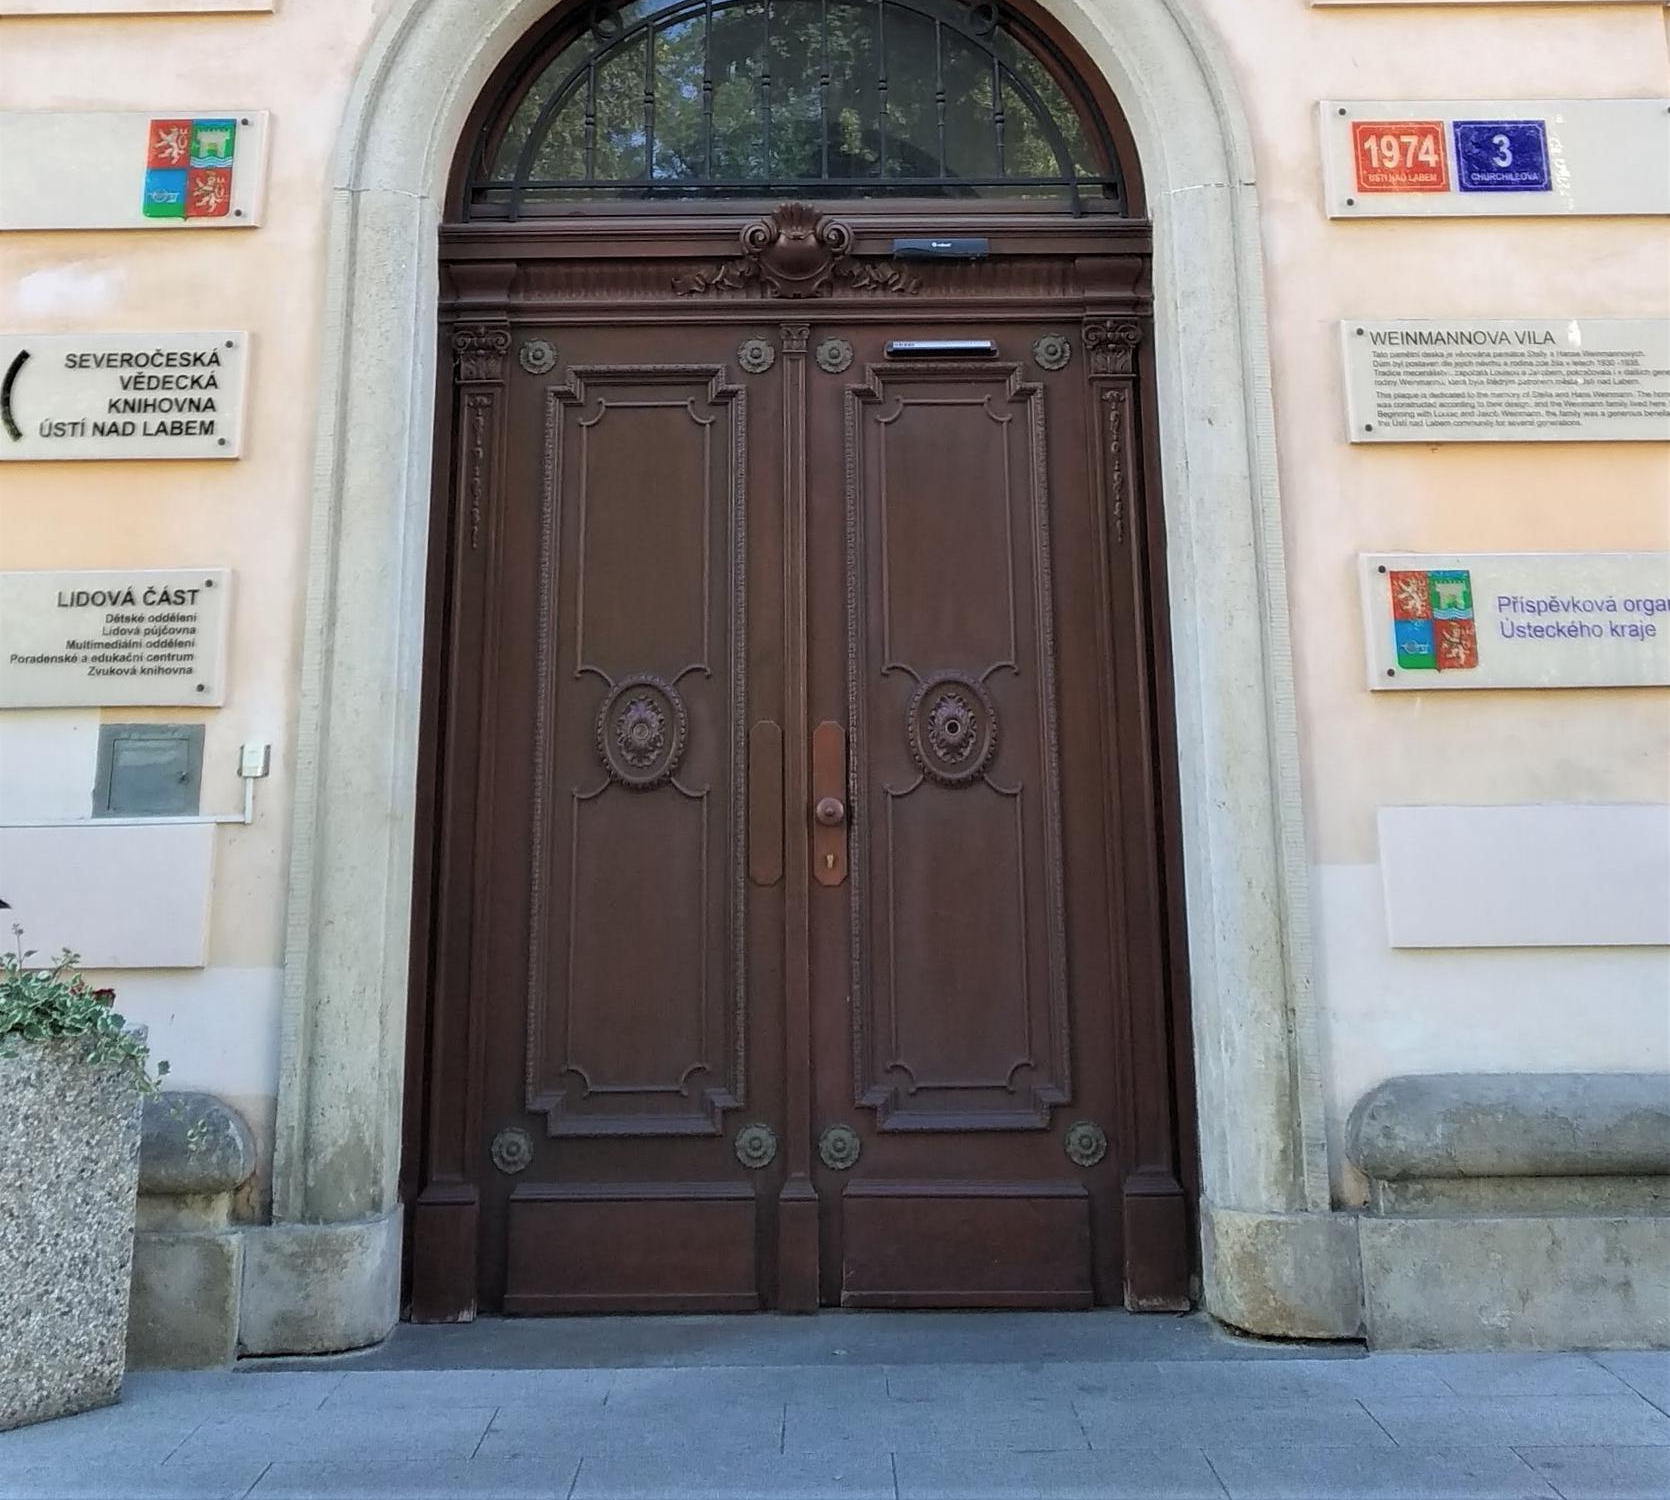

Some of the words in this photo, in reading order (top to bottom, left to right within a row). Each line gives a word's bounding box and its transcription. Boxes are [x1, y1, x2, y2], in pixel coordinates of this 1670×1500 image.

[1363, 134, 1438, 168] 1974
[1492, 134, 1513, 168] 3
[1370, 330, 1511, 346] WEINMANNOVA
[1513, 330, 1556, 345] VILA
[64, 349, 220, 369] SEVEROČESKÁ
[119, 371, 218, 390] VĚDECKÁ
[107, 397, 217, 414] KNIHOVNA
[39, 418, 86, 438] ÚSTÍ
[92, 421, 136, 437] NAD
[142, 420, 215, 436] LABEM
[57, 586, 136, 607] LIDOVÁ
[142, 586, 200, 606] ČÁST
[1497, 596, 1617, 616] Příspěvková
[105, 613, 145, 624] Dětské
[147, 612, 197, 623] oddělení
[102, 626, 141, 636] Lidová
[143, 625, 197, 638] půjčovna
[1500, 617, 1603, 638] Ústeckého
[1609, 620, 1657, 641] kraje
[66, 639, 142, 650] Multimediální
[146, 638, 196, 649] oddělení
[10, 653, 78, 664] Poradenské
[81, 655, 88, 663] a
[91, 652, 144, 663] edukační
[146, 652, 195, 662] centrum
[88, 665, 137, 676] Zvuková
[140, 665, 193, 675] knihovna
